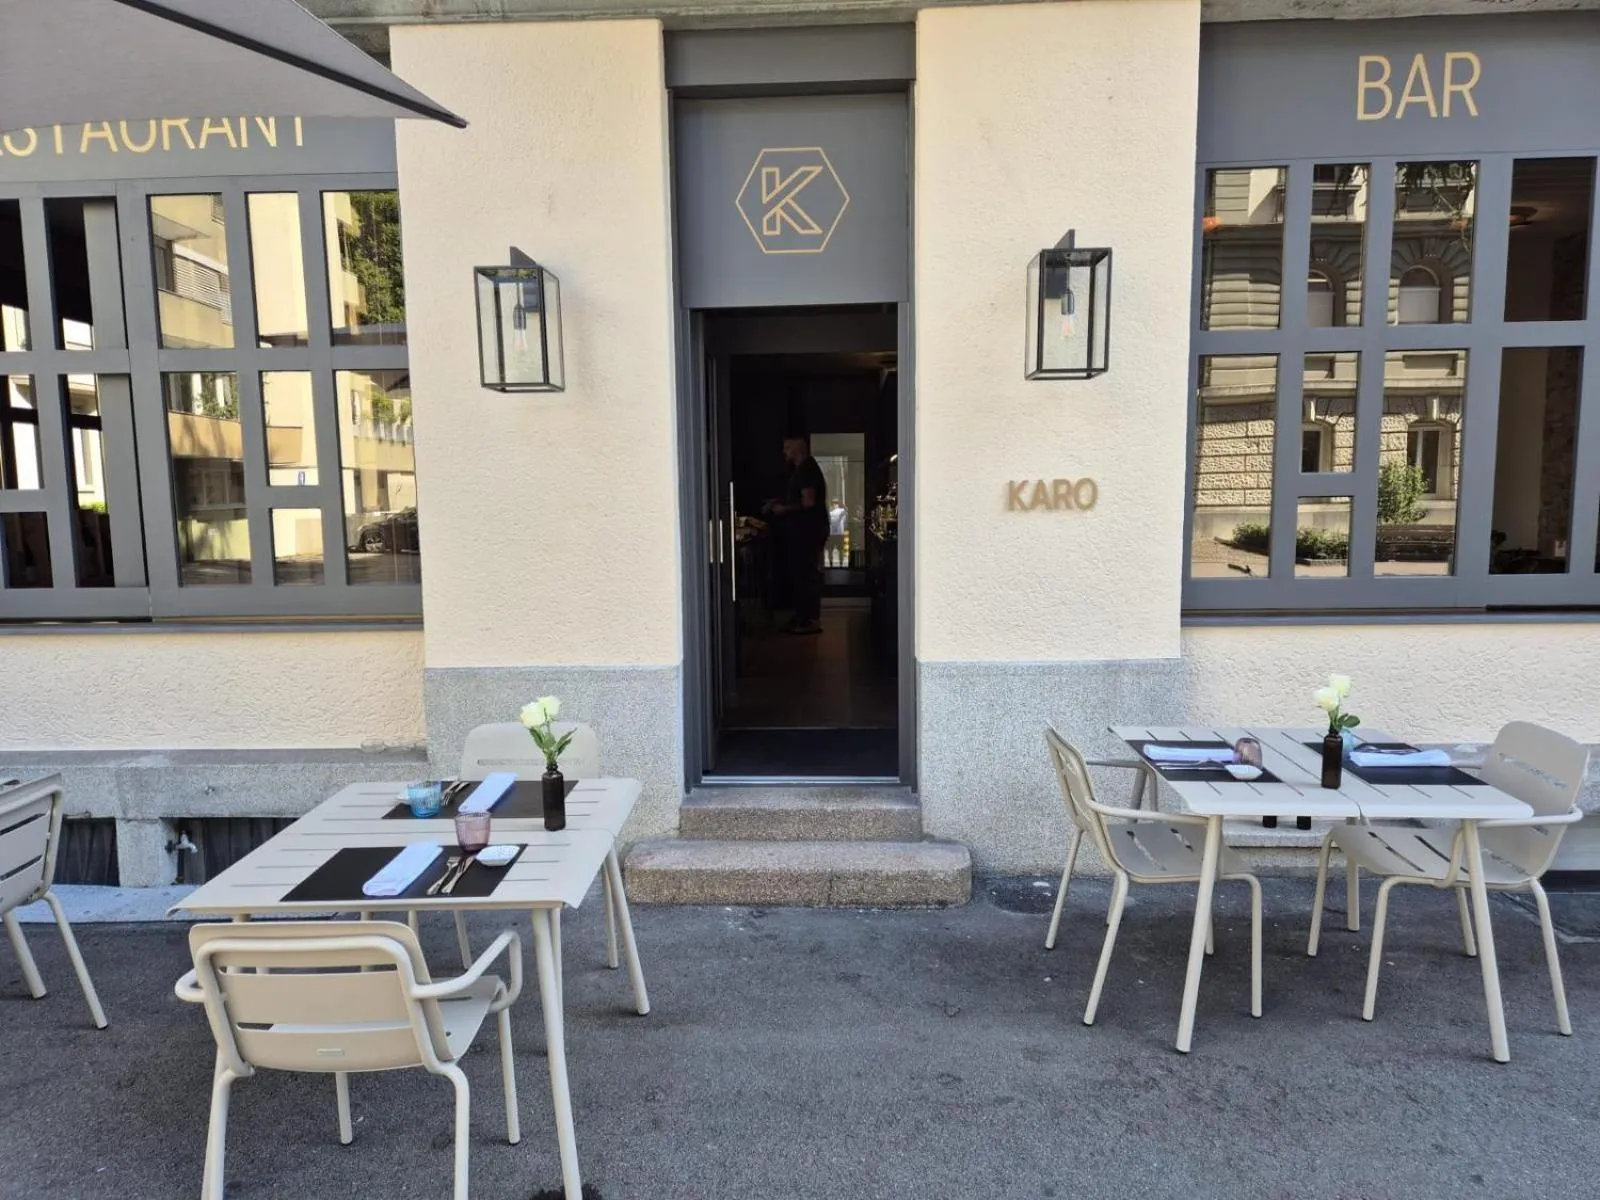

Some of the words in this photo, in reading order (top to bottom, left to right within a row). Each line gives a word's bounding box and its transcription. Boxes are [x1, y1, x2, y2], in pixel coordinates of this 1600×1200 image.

[1356, 51, 1482, 121] BAR
[0, 116, 305, 157] SAURAN
[761, 165, 824, 236] K
[1006, 477, 1098, 512] KARO
